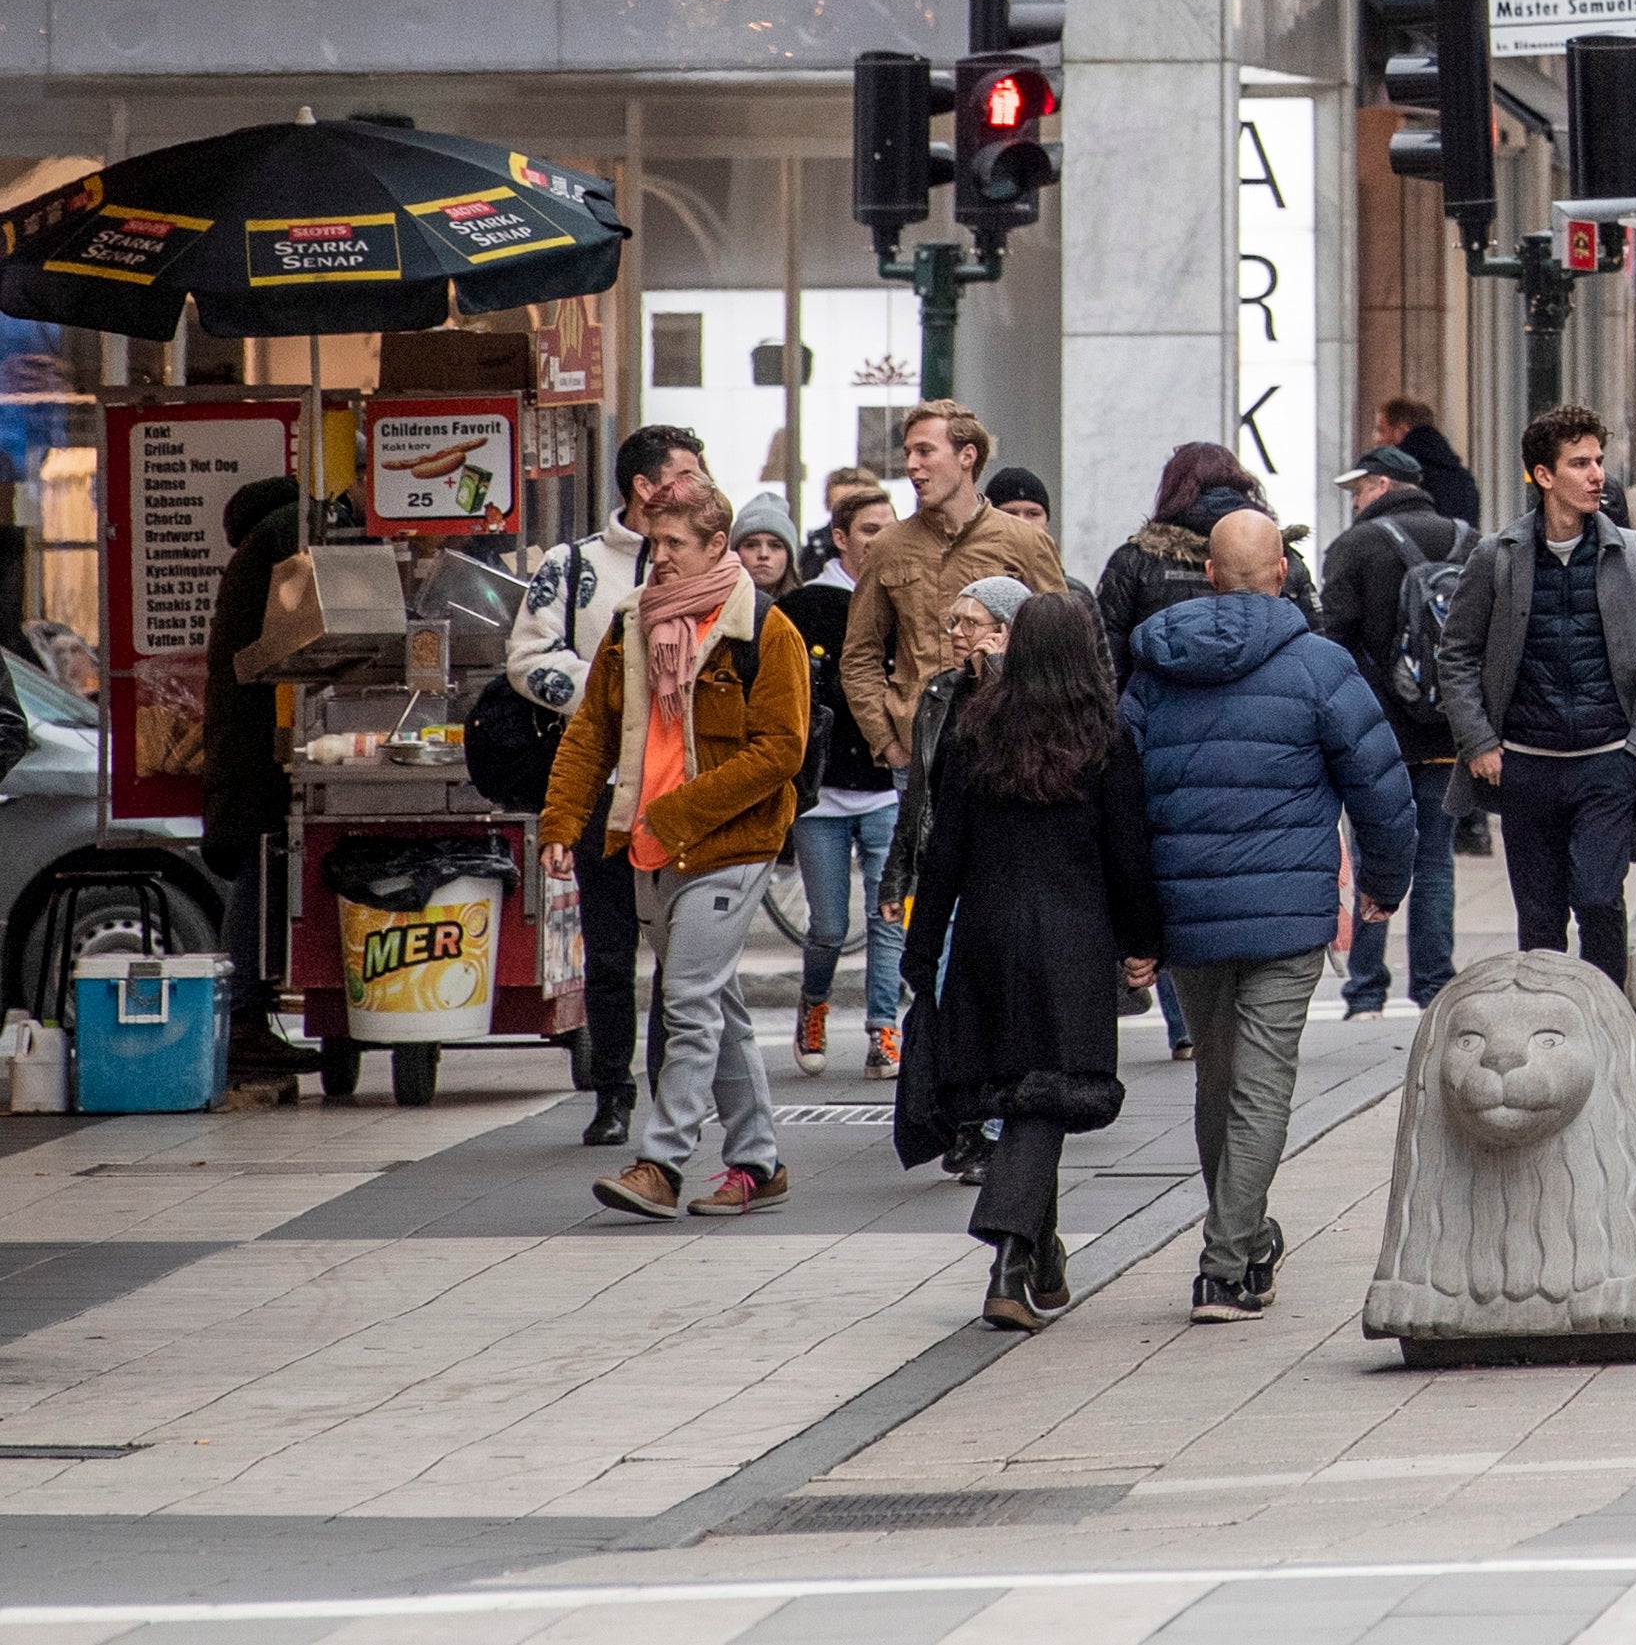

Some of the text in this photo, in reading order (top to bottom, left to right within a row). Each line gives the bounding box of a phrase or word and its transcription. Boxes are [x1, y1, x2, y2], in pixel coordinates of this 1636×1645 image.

[1496, 1, 1559, 18] Mäster
[448, 213, 525, 235] STARKA
[92, 230, 165, 254] STARKA
[469, 226, 532, 247] SENAP
[81, 243, 147, 266] SENAP
[273, 240, 369, 256] STARKA
[282, 255, 364, 270] SENAP
[381, 421, 501, 438] Childrens Favorit
[382, 442, 431, 452] Kokt korv
[144, 459, 239, 474] French Hot Dog
[144, 478, 186, 491] Bamse
[145, 495, 204, 508] Kabanoss
[408, 492, 434, 507] 25
[145, 512, 193, 525] Chorizo
[145, 530, 206, 543] Bratwurst
[145, 547, 211, 560] Lammkorv
[146, 565, 225, 579] Kycklingkorv
[146, 581, 209, 595] Läsk 33 cl
[146, 598, 211, 613] Smakis 20
[147, 615, 206, 630] Flaska 50
[147, 633, 205, 648] Vatten 50
[364, 921, 463, 982] MER
